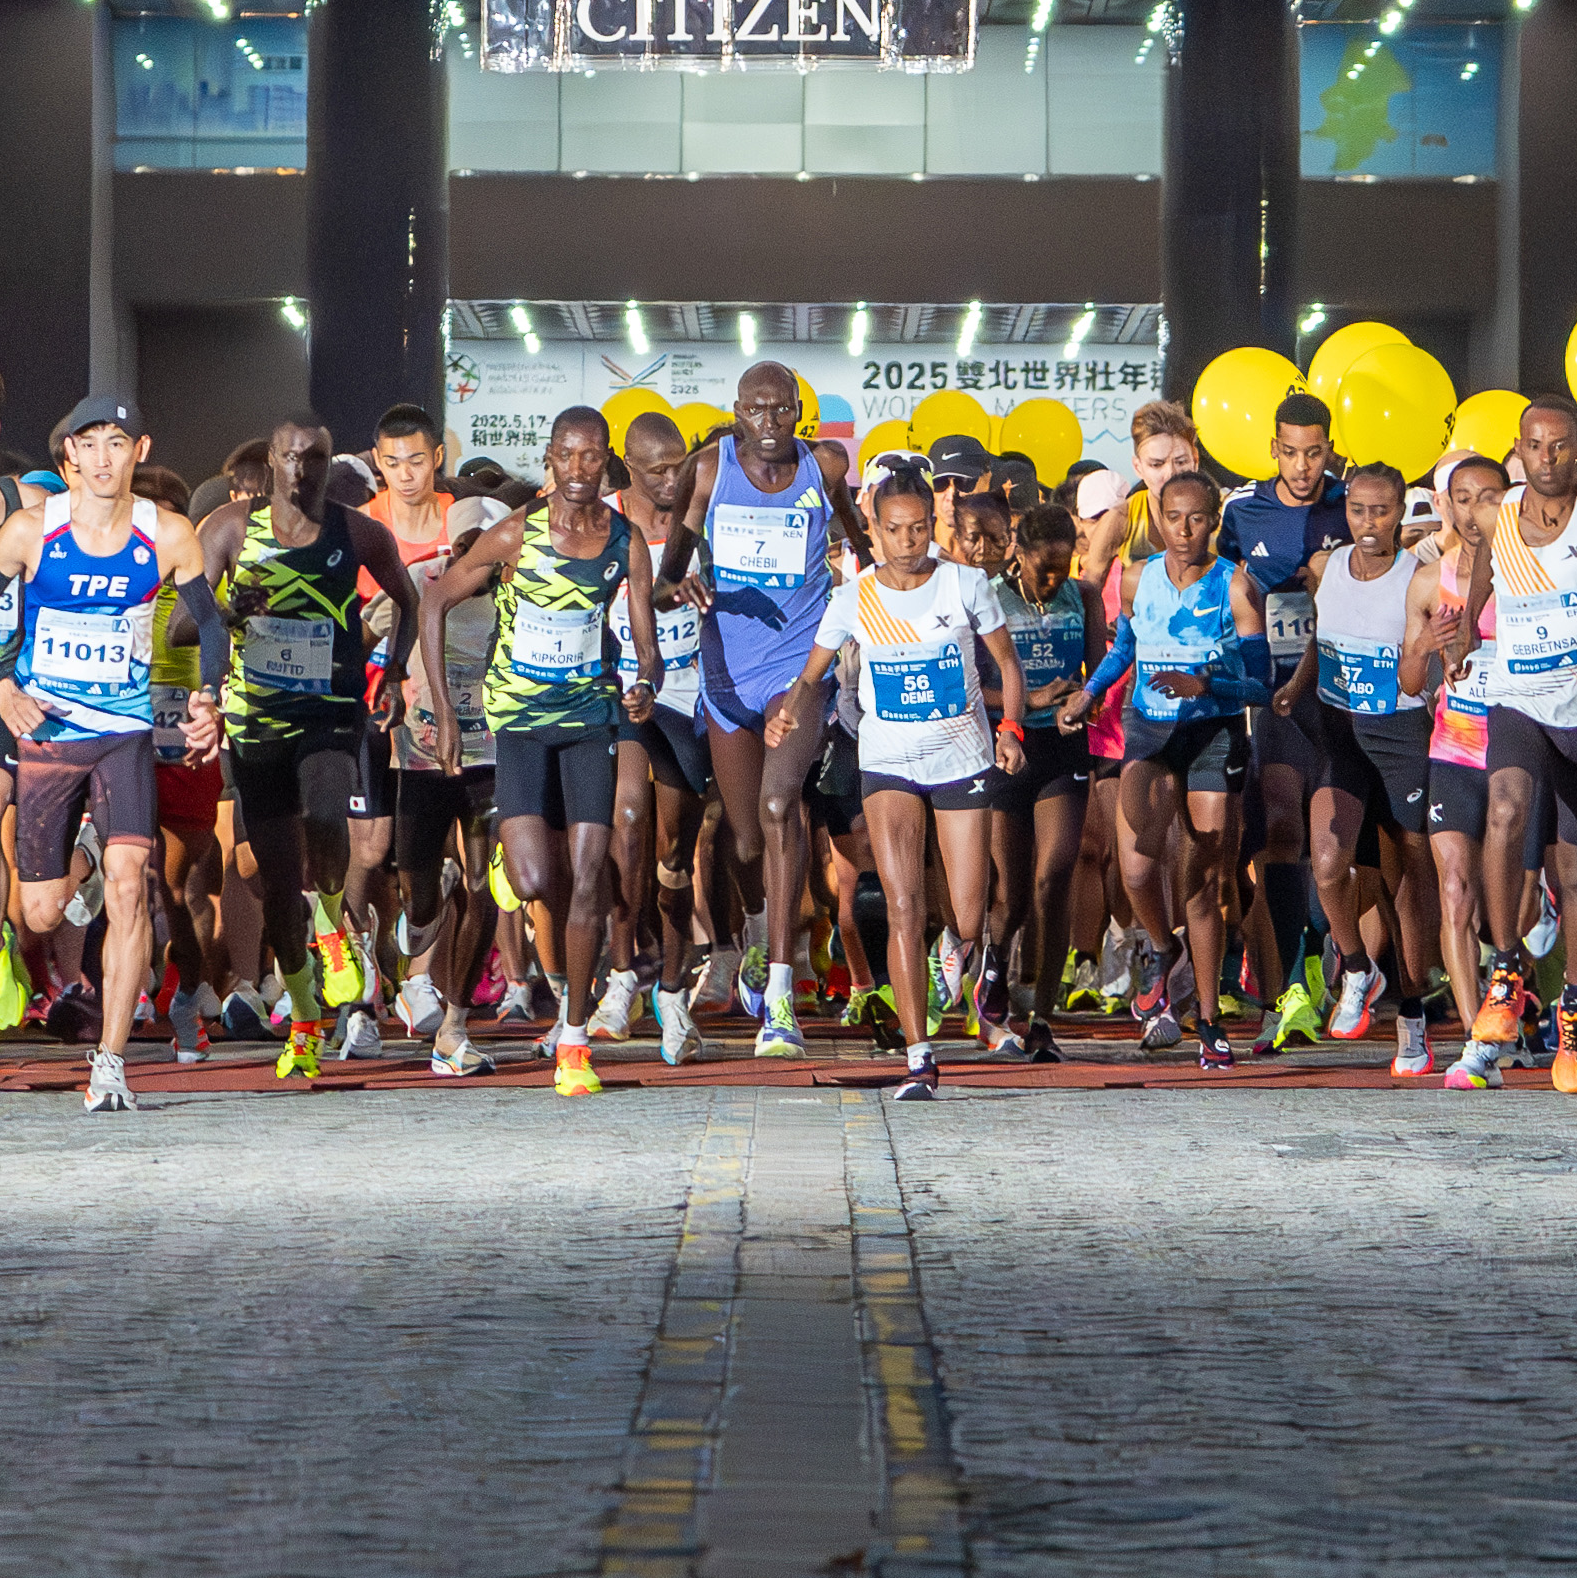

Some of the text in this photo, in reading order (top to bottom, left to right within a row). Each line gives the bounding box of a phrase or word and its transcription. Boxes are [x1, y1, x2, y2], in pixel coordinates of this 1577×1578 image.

[792, 514, 803, 528] A
[782, 530, 804, 539] KEN
[754, 540, 766, 555] 7
[739, 555, 778, 569] CHEBII
[68, 573, 131, 598] TPE
[117, 618, 131, 632] A
[1536, 625, 1549, 640] 9
[41, 636, 126, 664] 11013
[553, 639, 563, 653] 1
[945, 644, 958, 656] A
[1031, 643, 1054, 658] 52
[1380, 647, 1393, 658] A
[280, 648, 293, 662] 6
[530, 650, 585, 665] KIPKORIR
[937, 658, 960, 670] ETH
[1373, 658, 1395, 669] ETH
[1341, 666, 1364, 682] 57
[903, 674, 931, 692] 56
[900, 689, 936, 705] DEME
